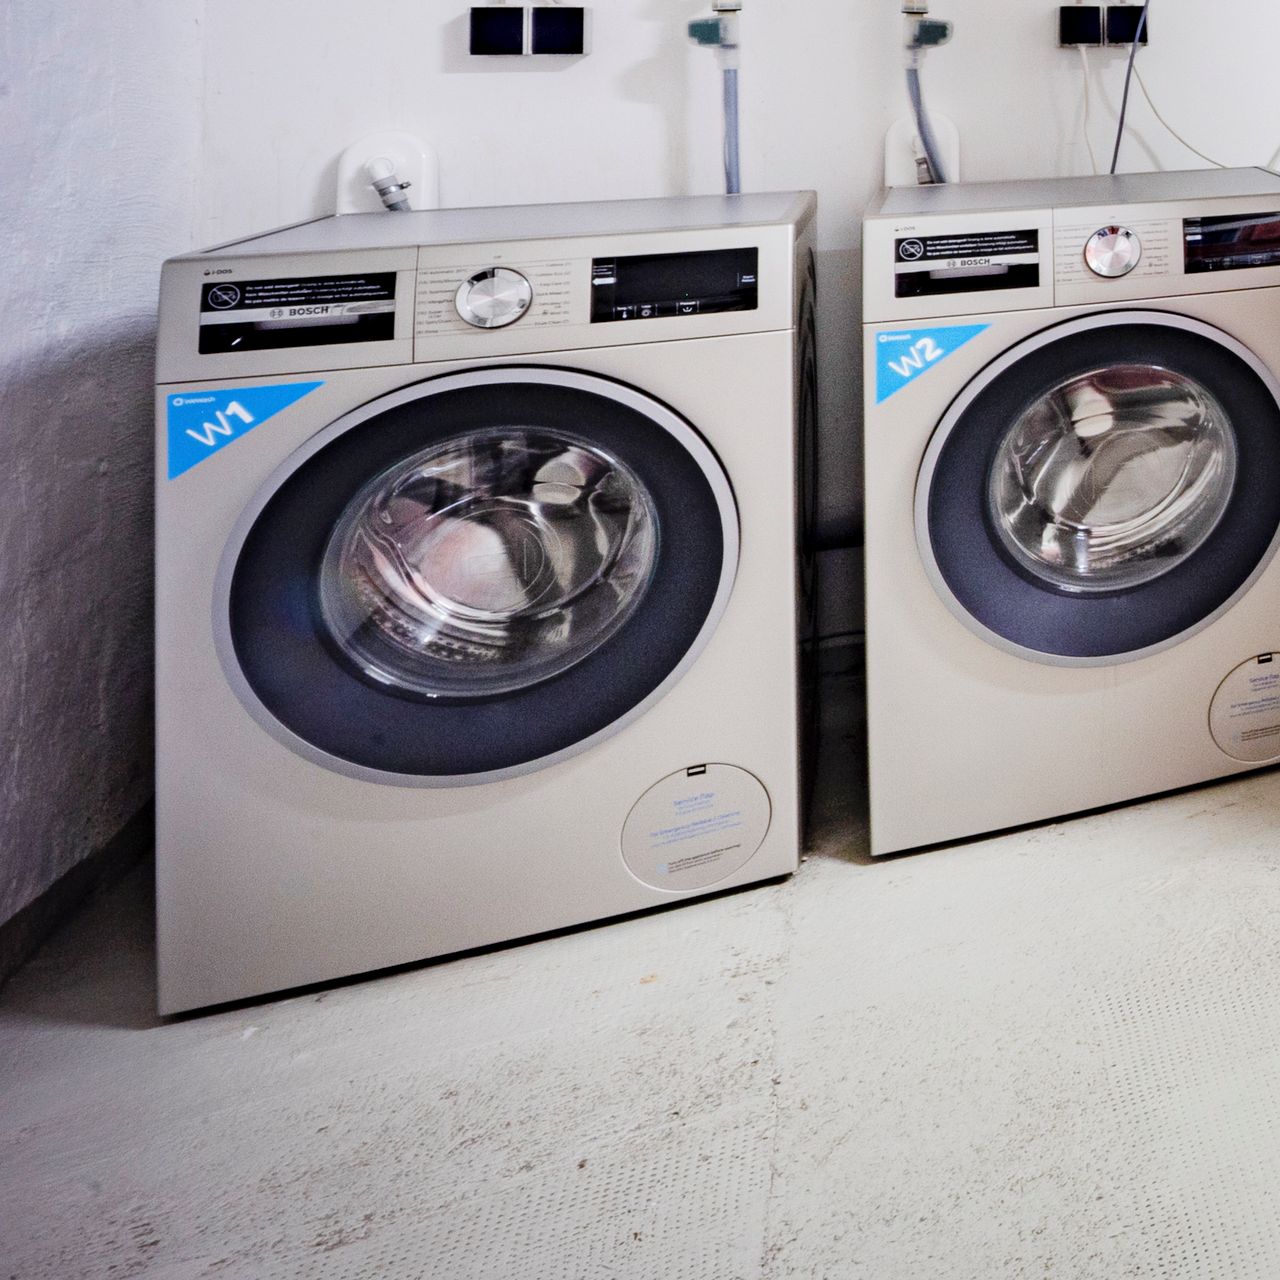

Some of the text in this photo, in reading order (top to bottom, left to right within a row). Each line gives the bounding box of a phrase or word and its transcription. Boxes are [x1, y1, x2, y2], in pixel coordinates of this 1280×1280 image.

[289, 306, 329, 317] BOSCH
[888, 337, 944, 377] W2
[186, 401, 255, 446] W1
